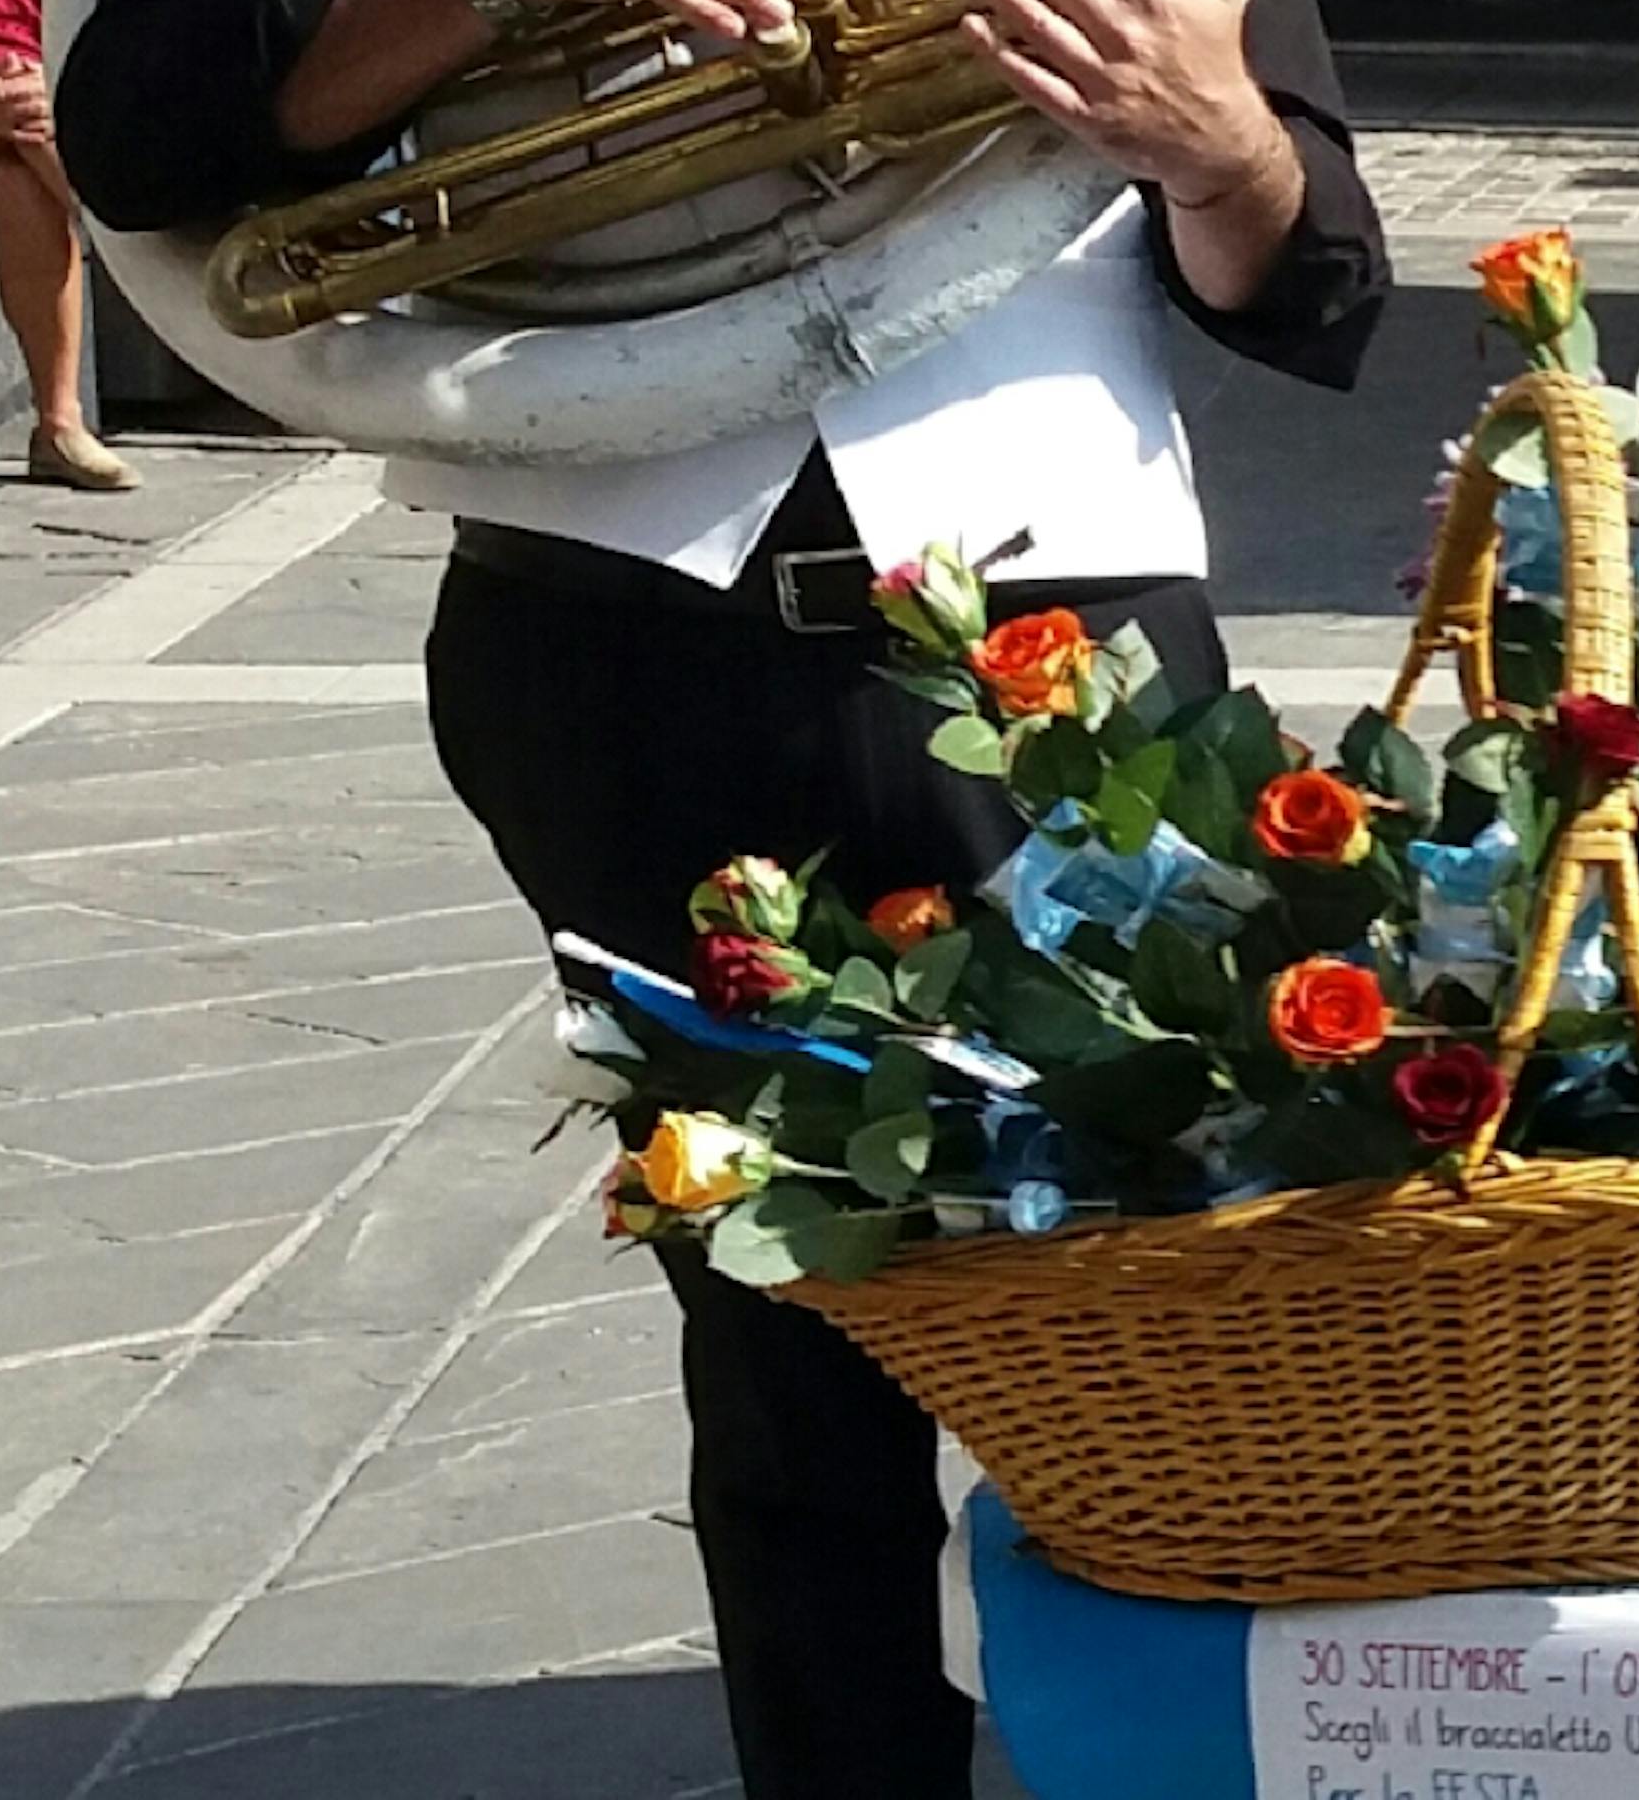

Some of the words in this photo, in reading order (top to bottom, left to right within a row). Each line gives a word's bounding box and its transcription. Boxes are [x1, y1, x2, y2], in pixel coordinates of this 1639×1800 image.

[1299, 1639, 1344, 1687] 30
[1360, 1642, 1530, 1695] SETTEMBRE
[1303, 1701, 1392, 1761] Scegli
[1404, 1707, 1422, 1747] il
[1436, 1710, 1613, 1755] braccialetto
[1431, 1767, 1540, 1800] FESTA
